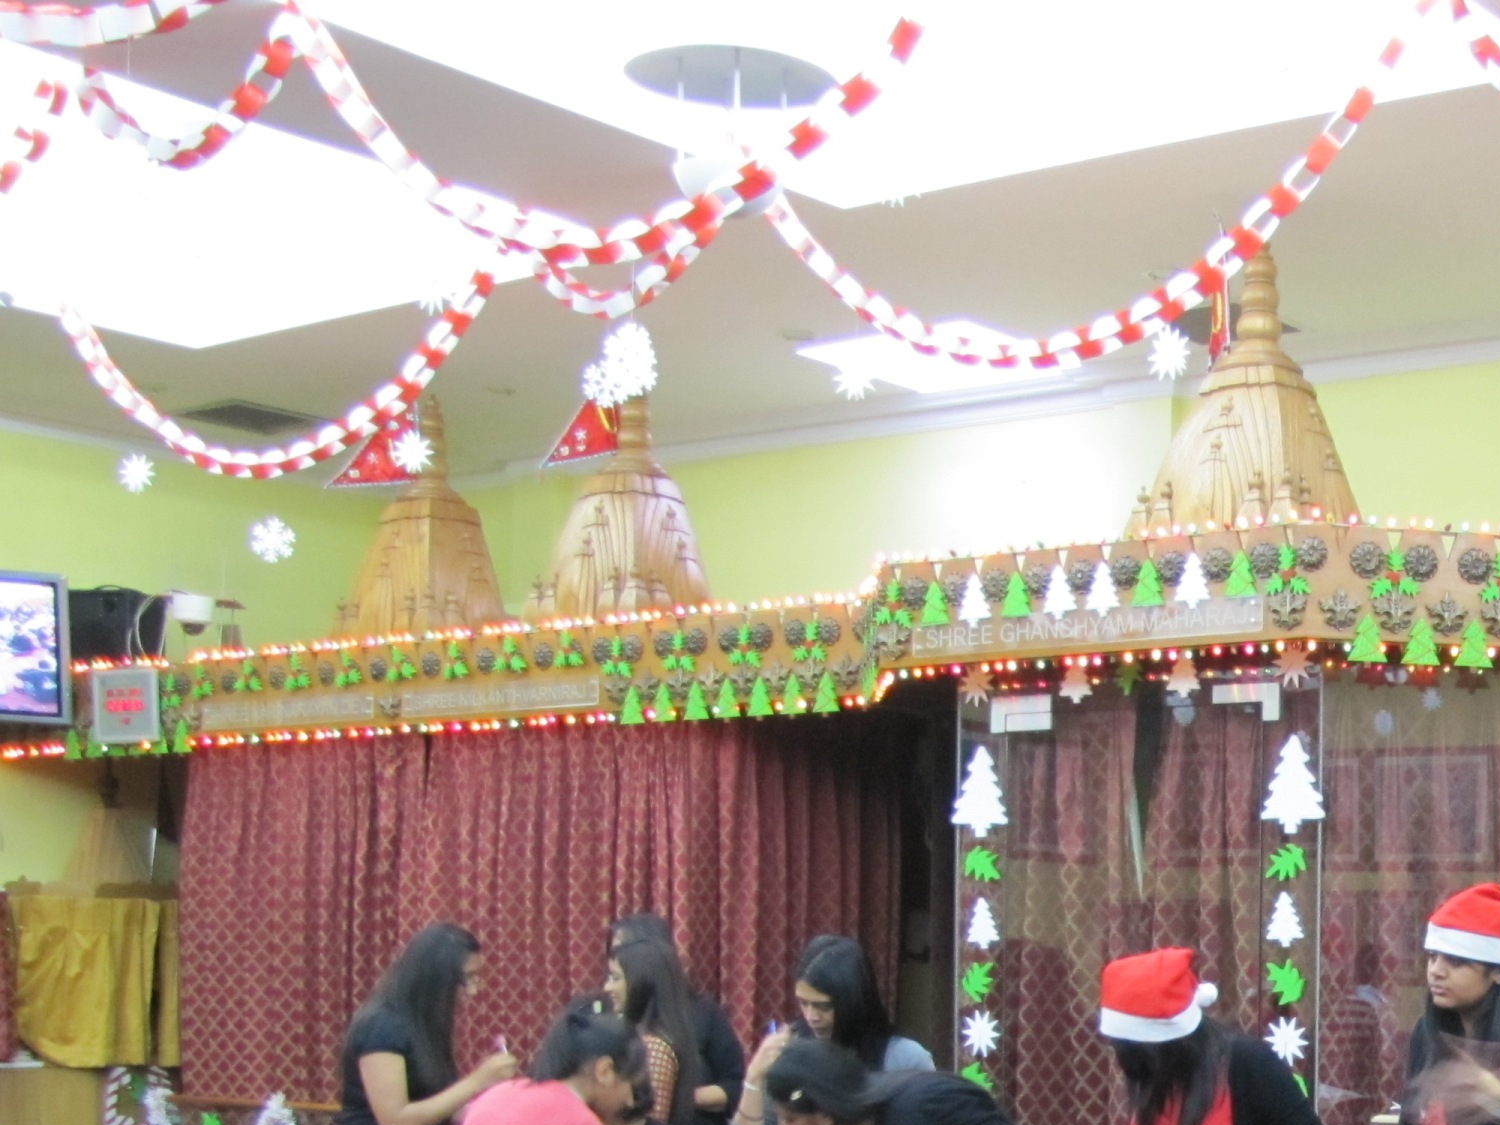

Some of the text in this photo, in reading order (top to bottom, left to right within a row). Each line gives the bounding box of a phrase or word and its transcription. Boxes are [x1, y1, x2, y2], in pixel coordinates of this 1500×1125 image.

[926, 603, 1248, 649] SHREE GHANSHYAM MAHARAJ
